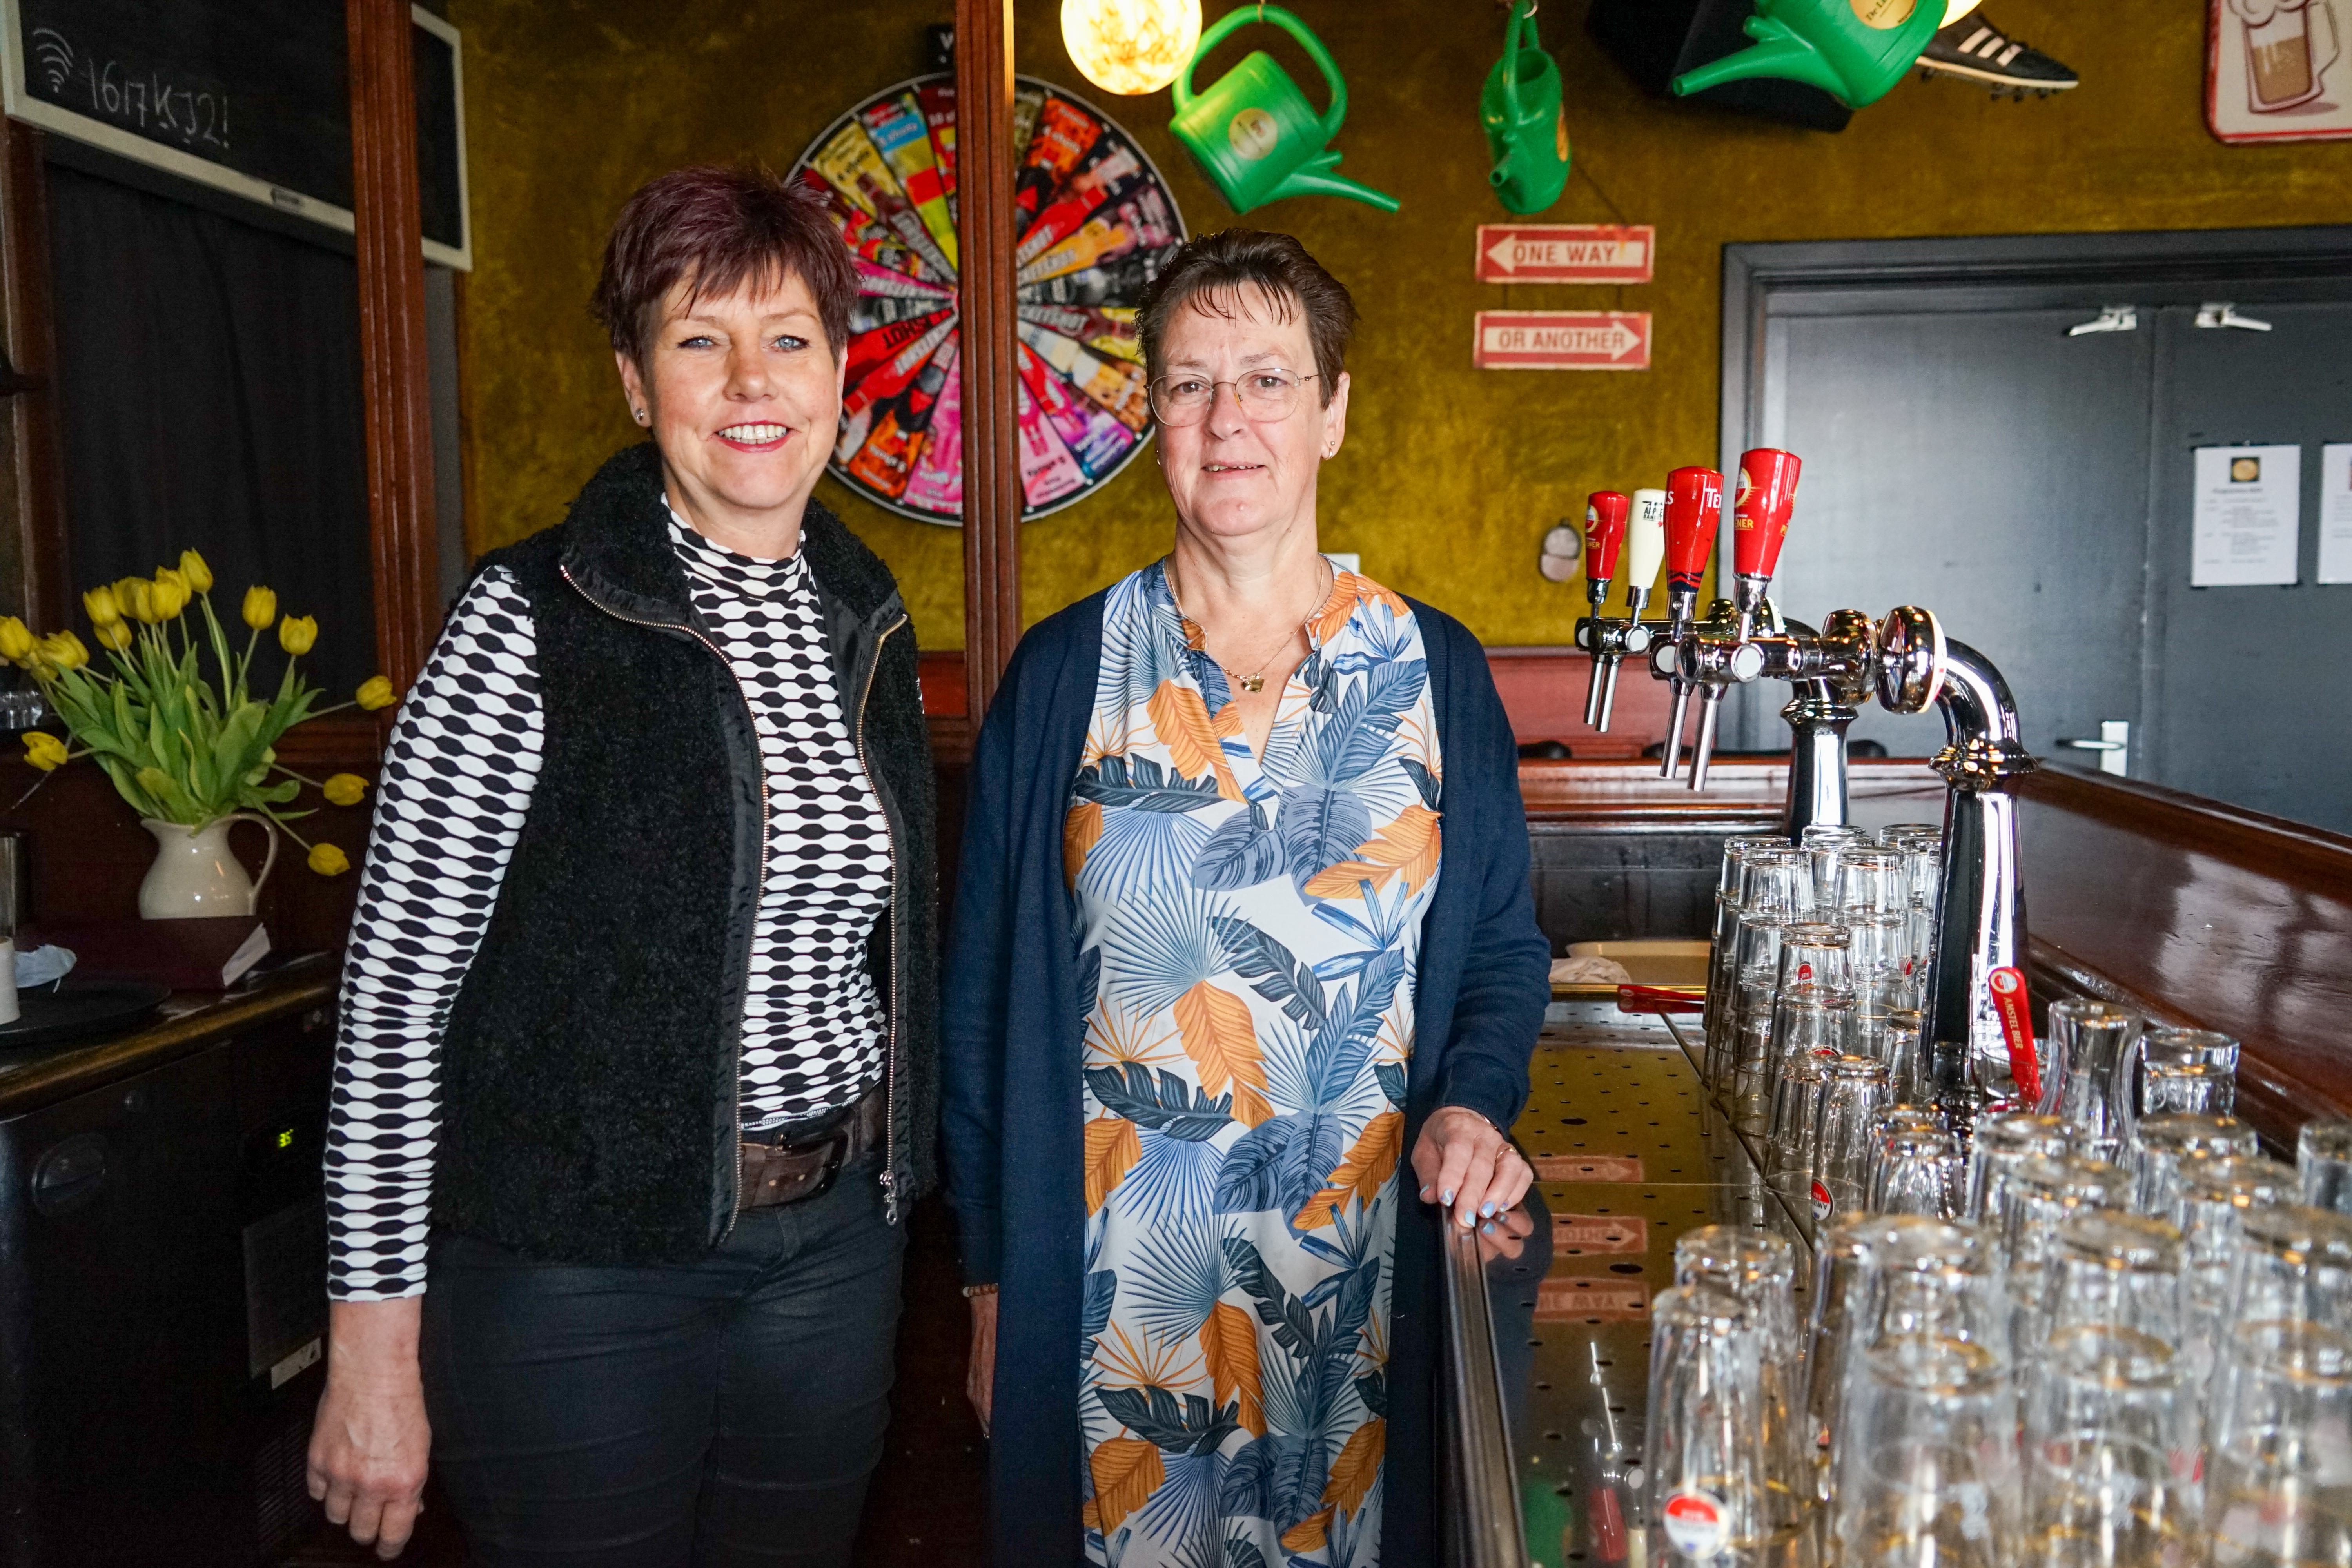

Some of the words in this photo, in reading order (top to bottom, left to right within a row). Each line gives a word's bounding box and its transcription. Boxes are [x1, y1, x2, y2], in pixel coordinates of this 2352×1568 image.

[1512, 244, 1557, 263] ONE
[1567, 244, 1615, 262] WAY
[1498, 331, 1525, 348] OR
[1533, 331, 1625, 349] ANOTHER
[2003, 996, 2019, 1030] AMSTEL
[2011, 1030, 2024, 1050] BIER
